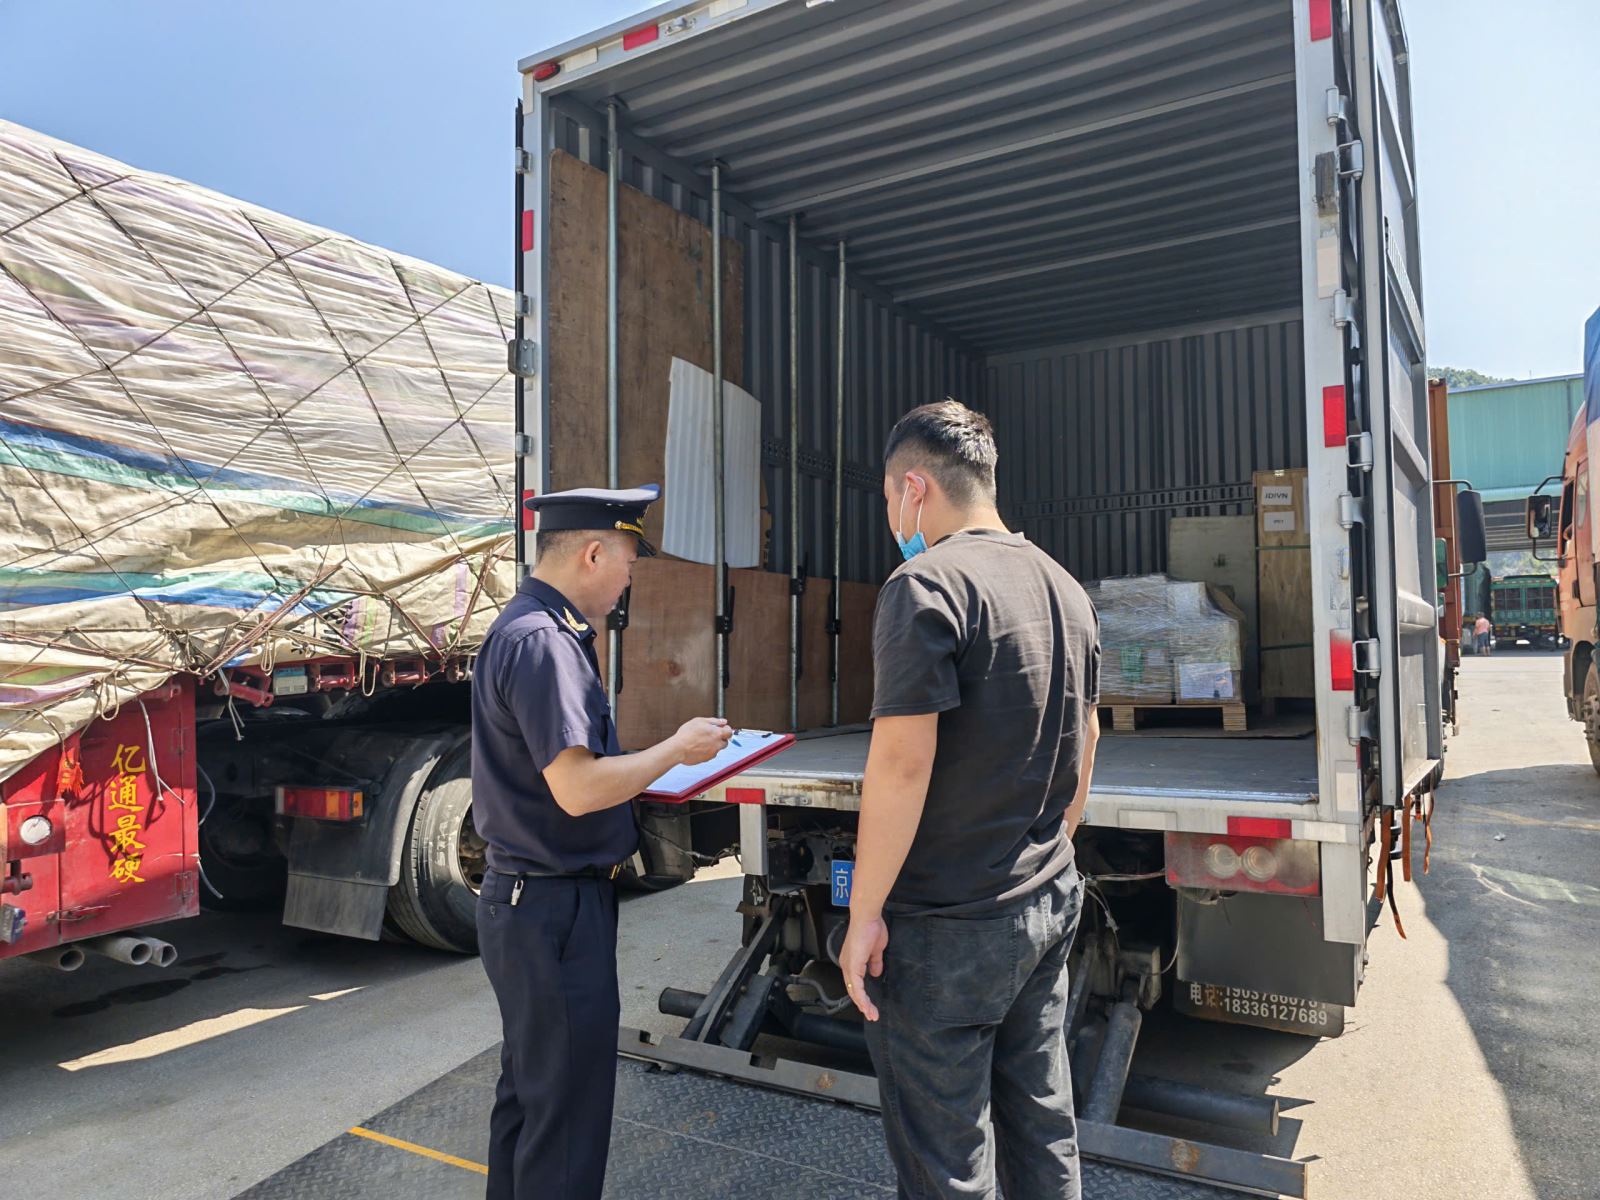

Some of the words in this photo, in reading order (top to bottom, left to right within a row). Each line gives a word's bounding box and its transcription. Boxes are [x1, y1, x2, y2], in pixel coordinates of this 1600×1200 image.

[108, 743, 146, 883] 亿通最硬
[835, 868, 848, 898] 京
[1224, 997, 1328, 1026] 18336127689
